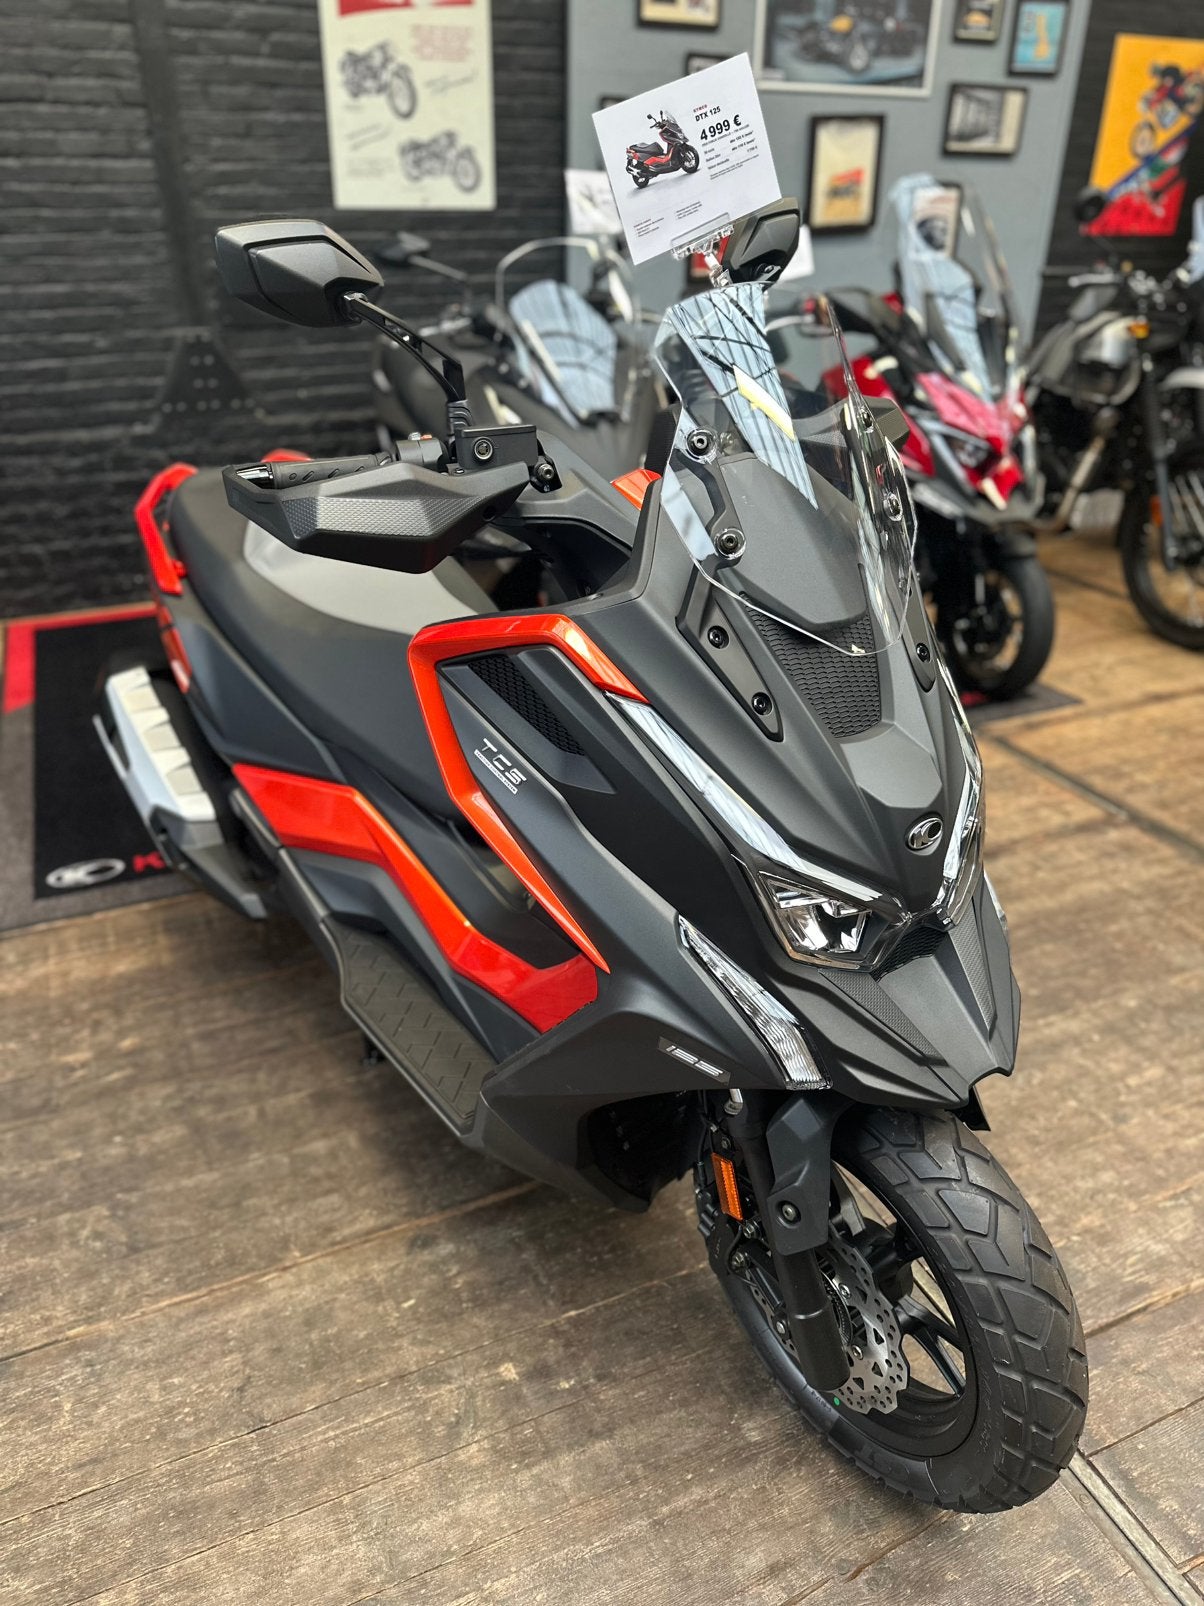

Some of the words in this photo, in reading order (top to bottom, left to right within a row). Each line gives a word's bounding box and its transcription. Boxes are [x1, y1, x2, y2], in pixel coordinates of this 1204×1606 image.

[695, 111, 708, 122] DTX
[709, 105, 721, 116] 125
[733, 114, 742, 127] €
[481, 737, 527, 785] TCS
[665, 1045, 723, 1077] 125
